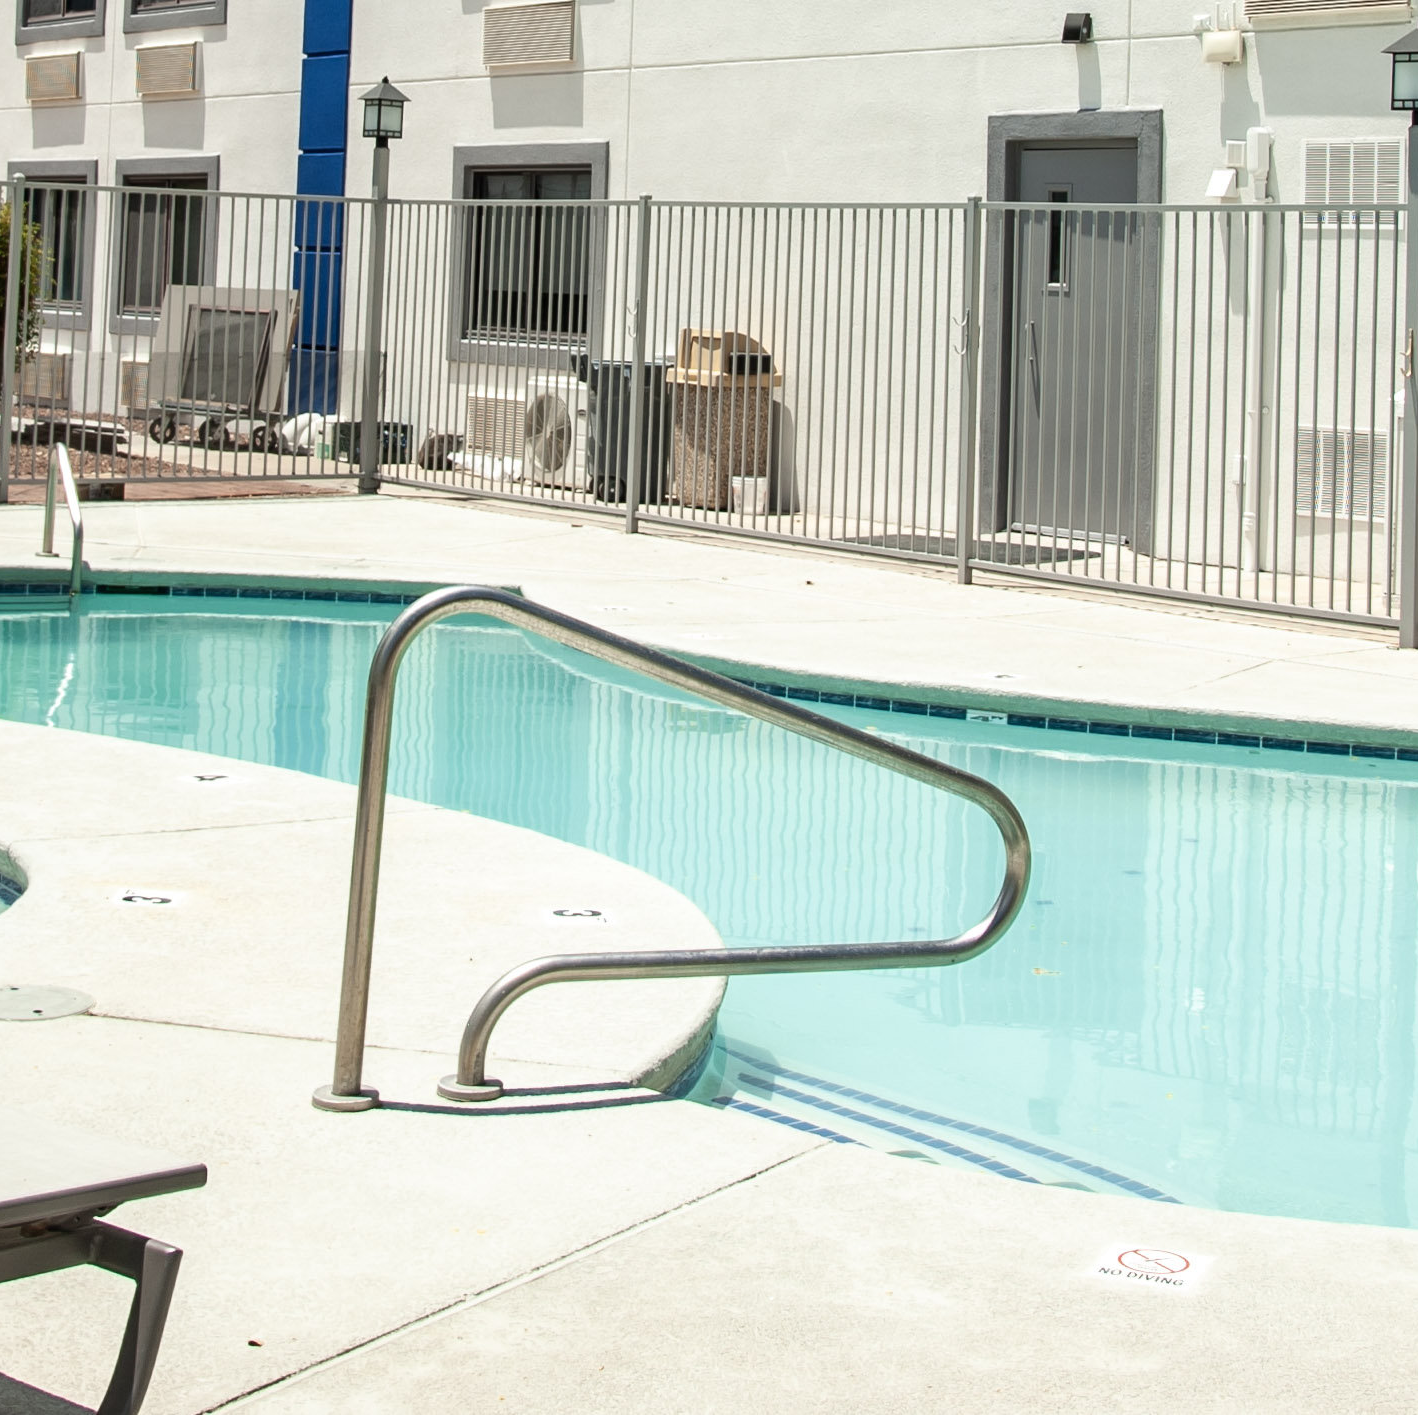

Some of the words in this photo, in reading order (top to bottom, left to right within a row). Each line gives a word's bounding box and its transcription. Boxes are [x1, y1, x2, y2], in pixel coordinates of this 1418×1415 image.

[122, 895, 172, 904] 3
[552, 909, 602, 917] 3
[1098, 1267, 1123, 1276] NO
[1126, 1271, 1185, 1286] DIVING
